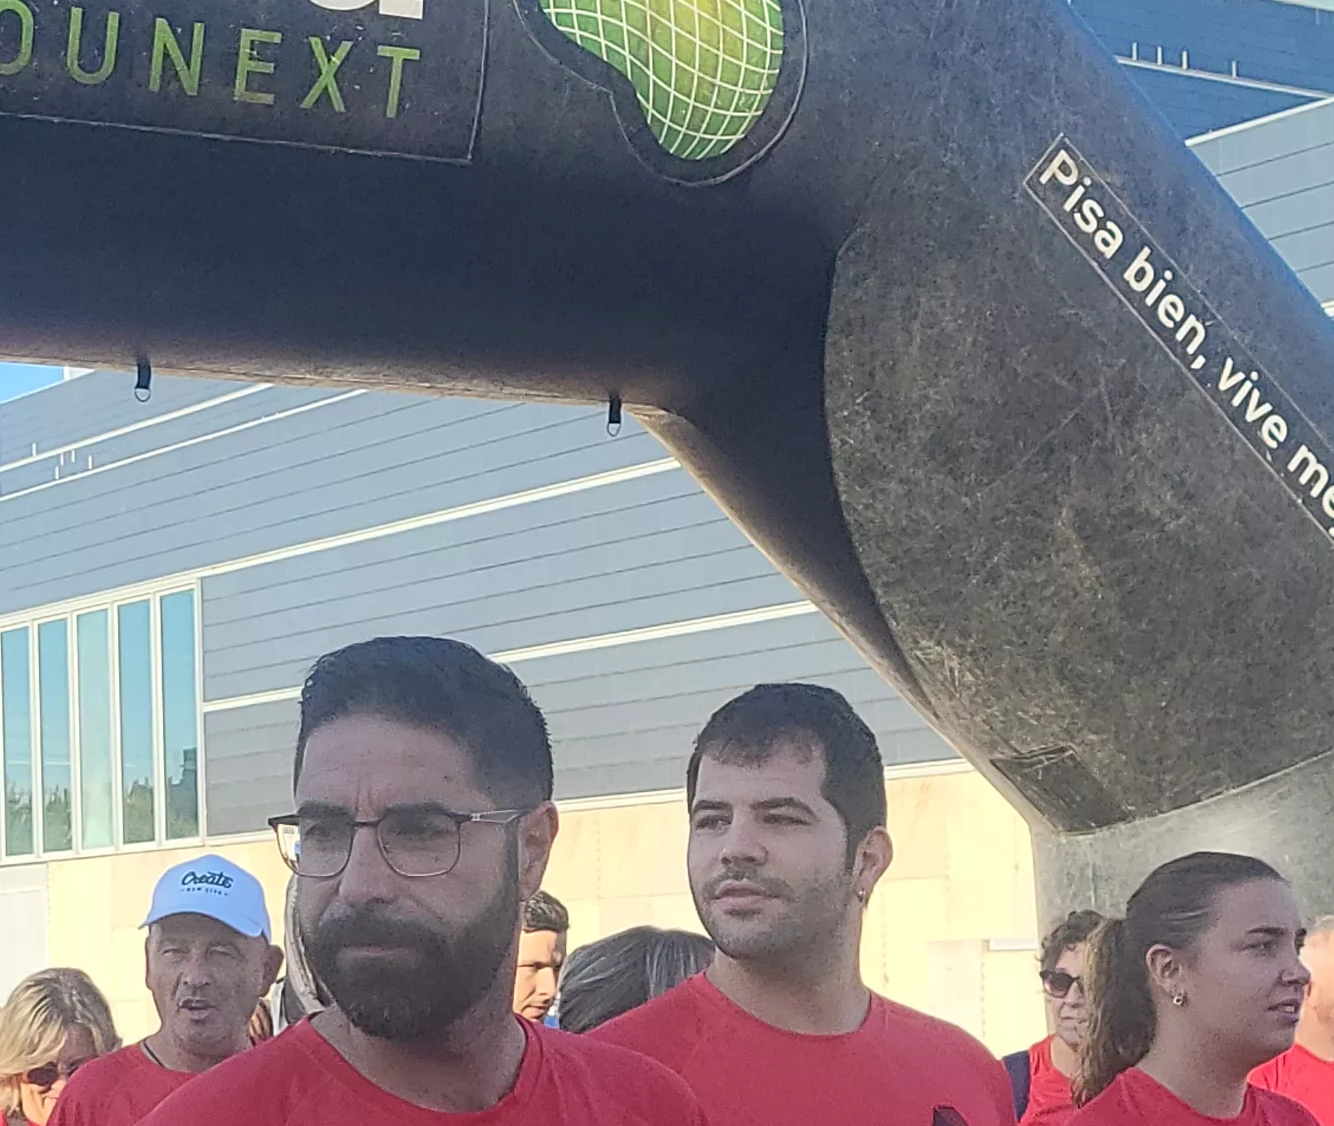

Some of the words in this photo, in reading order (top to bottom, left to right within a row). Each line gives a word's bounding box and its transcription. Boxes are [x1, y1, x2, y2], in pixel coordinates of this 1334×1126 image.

[1039, 149, 1124, 259] Pisa
[1123, 246, 1209, 370] bien,
[1216, 356, 1289, 449] vive
[181, 870, 234, 888] Create
